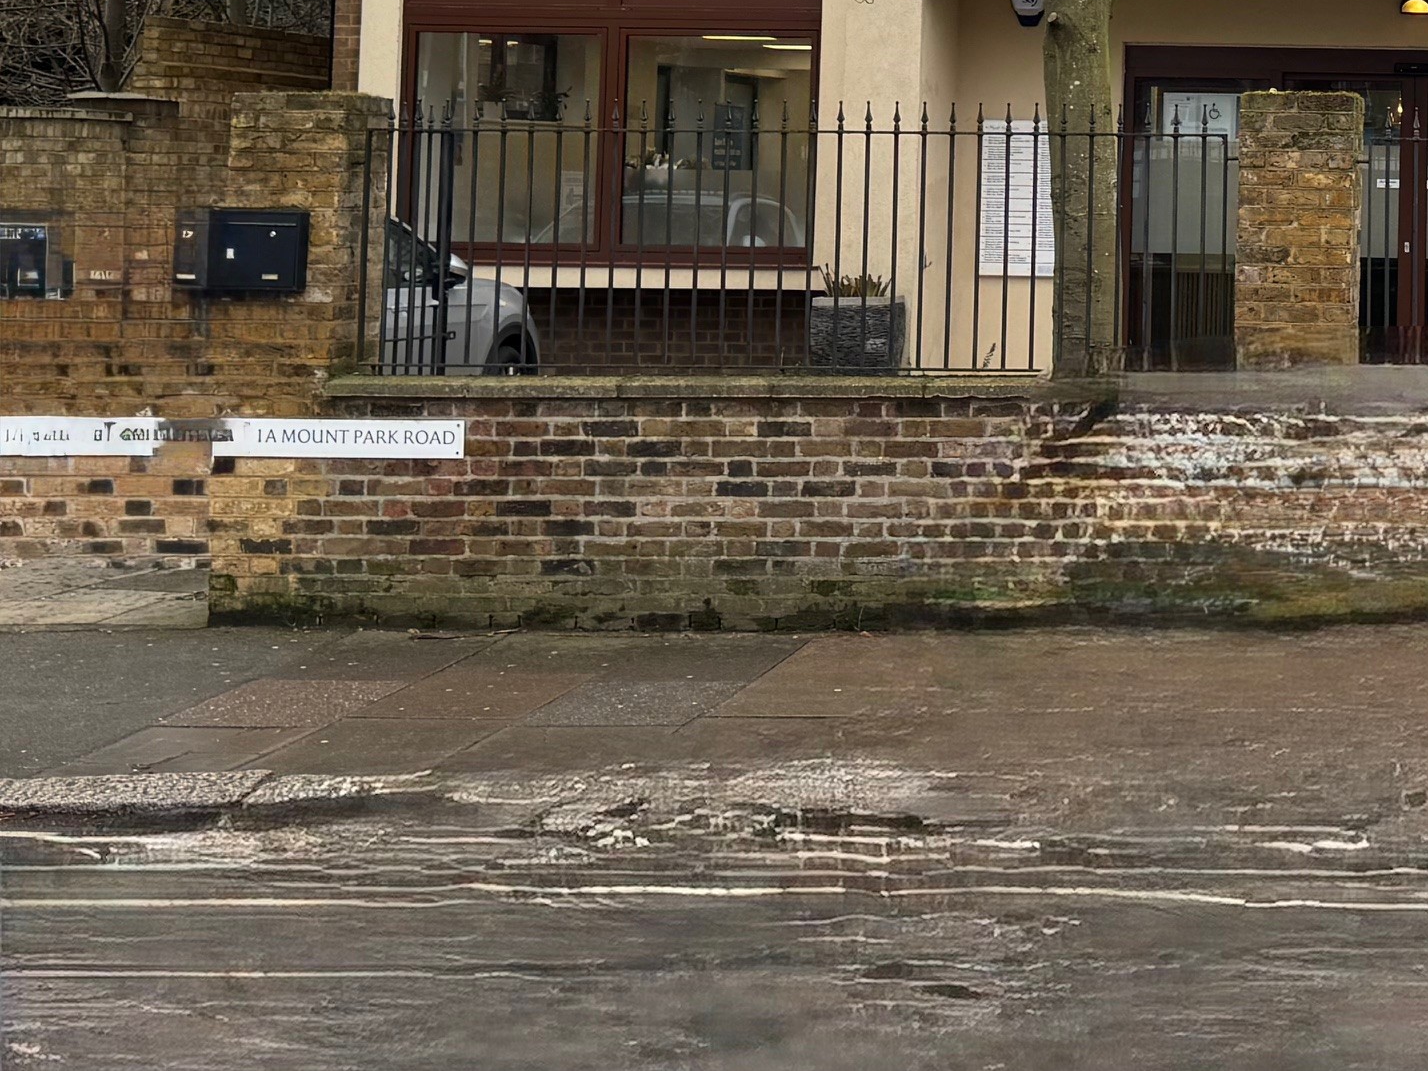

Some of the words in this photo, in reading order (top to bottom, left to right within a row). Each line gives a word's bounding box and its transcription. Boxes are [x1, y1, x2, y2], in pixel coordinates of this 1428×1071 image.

[257, 429, 277, 443] 1A
[281, 429, 349, 444] MOUNT
[354, 430, 399, 445] PARK
[404, 430, 455, 445] ROAD
